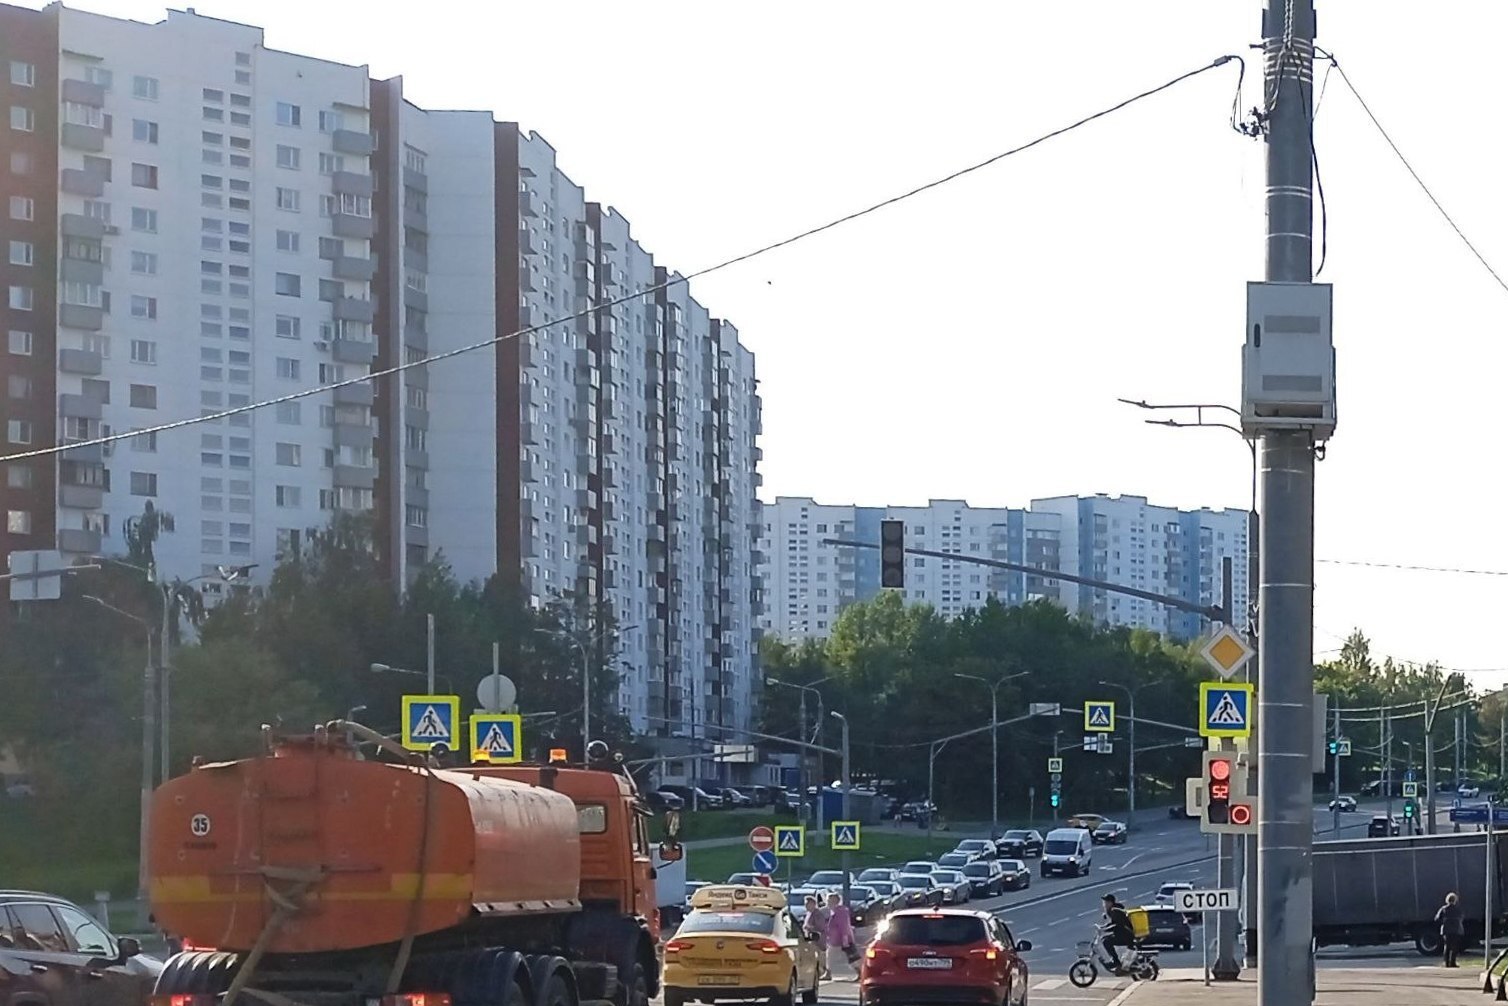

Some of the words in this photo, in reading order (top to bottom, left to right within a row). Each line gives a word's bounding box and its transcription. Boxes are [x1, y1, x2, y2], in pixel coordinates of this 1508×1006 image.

[1212, 785, 1229, 799] 52
[194, 817, 207, 832] 35
[1183, 892, 1229, 908] СТОП
